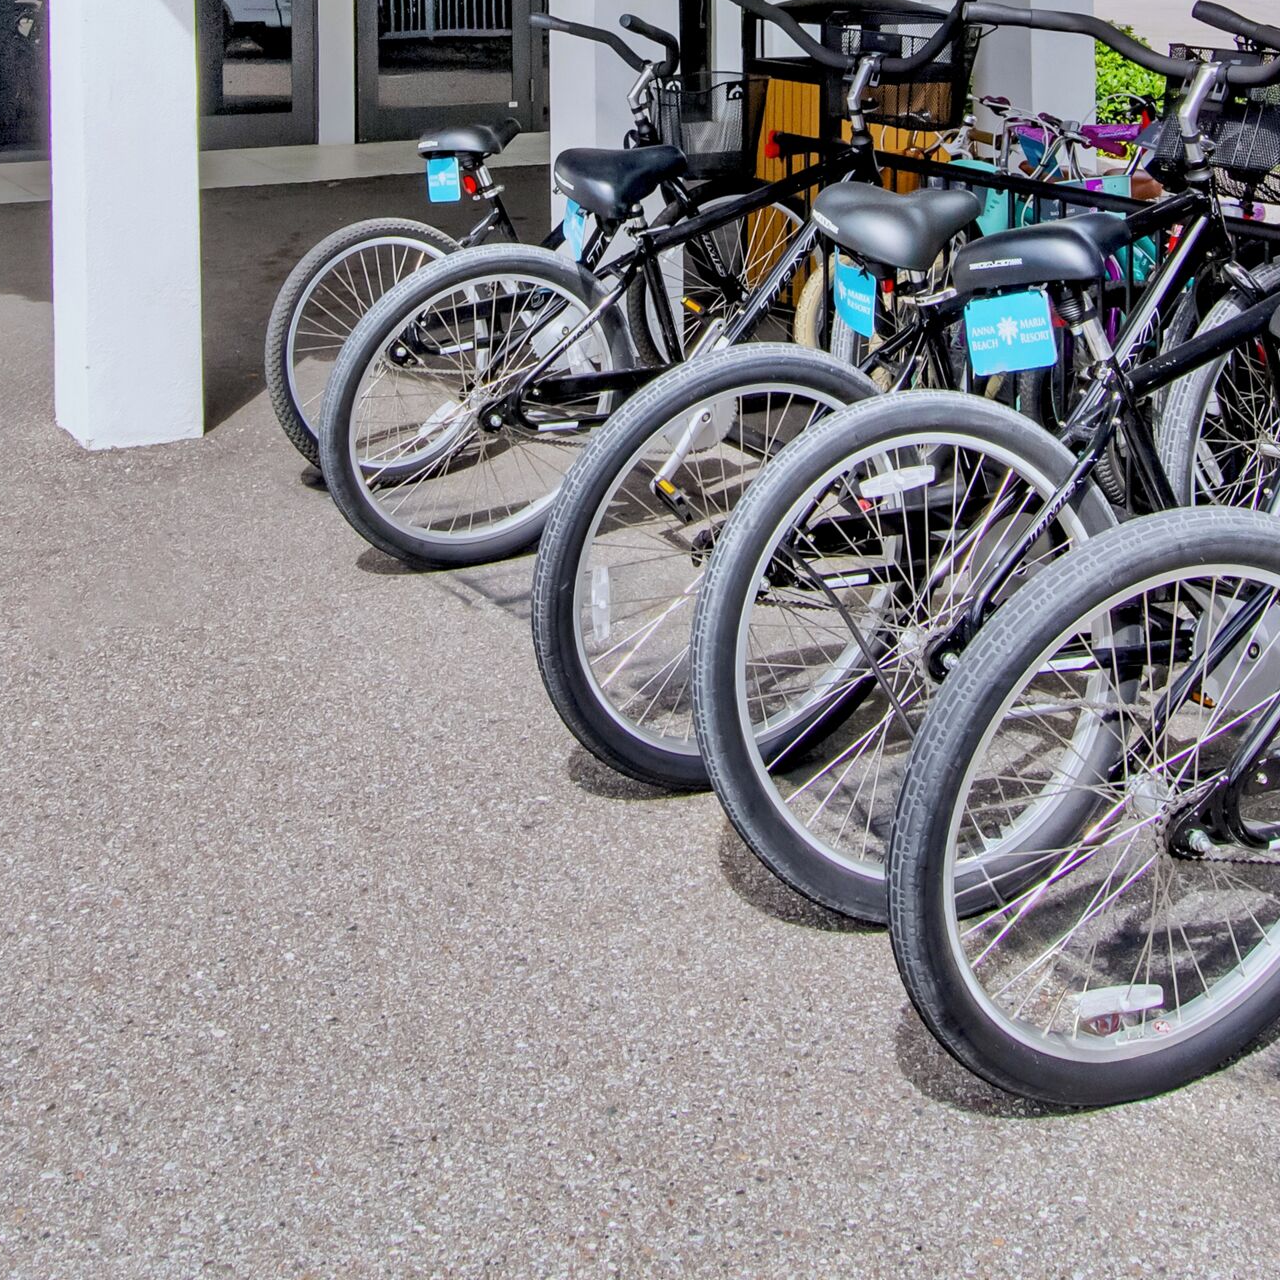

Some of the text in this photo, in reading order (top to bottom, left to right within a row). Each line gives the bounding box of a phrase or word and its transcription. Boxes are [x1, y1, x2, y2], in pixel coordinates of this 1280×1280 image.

[972, 316, 1046, 337] ANNA MARIA
[971, 329, 1050, 351] BEACH RESORT
